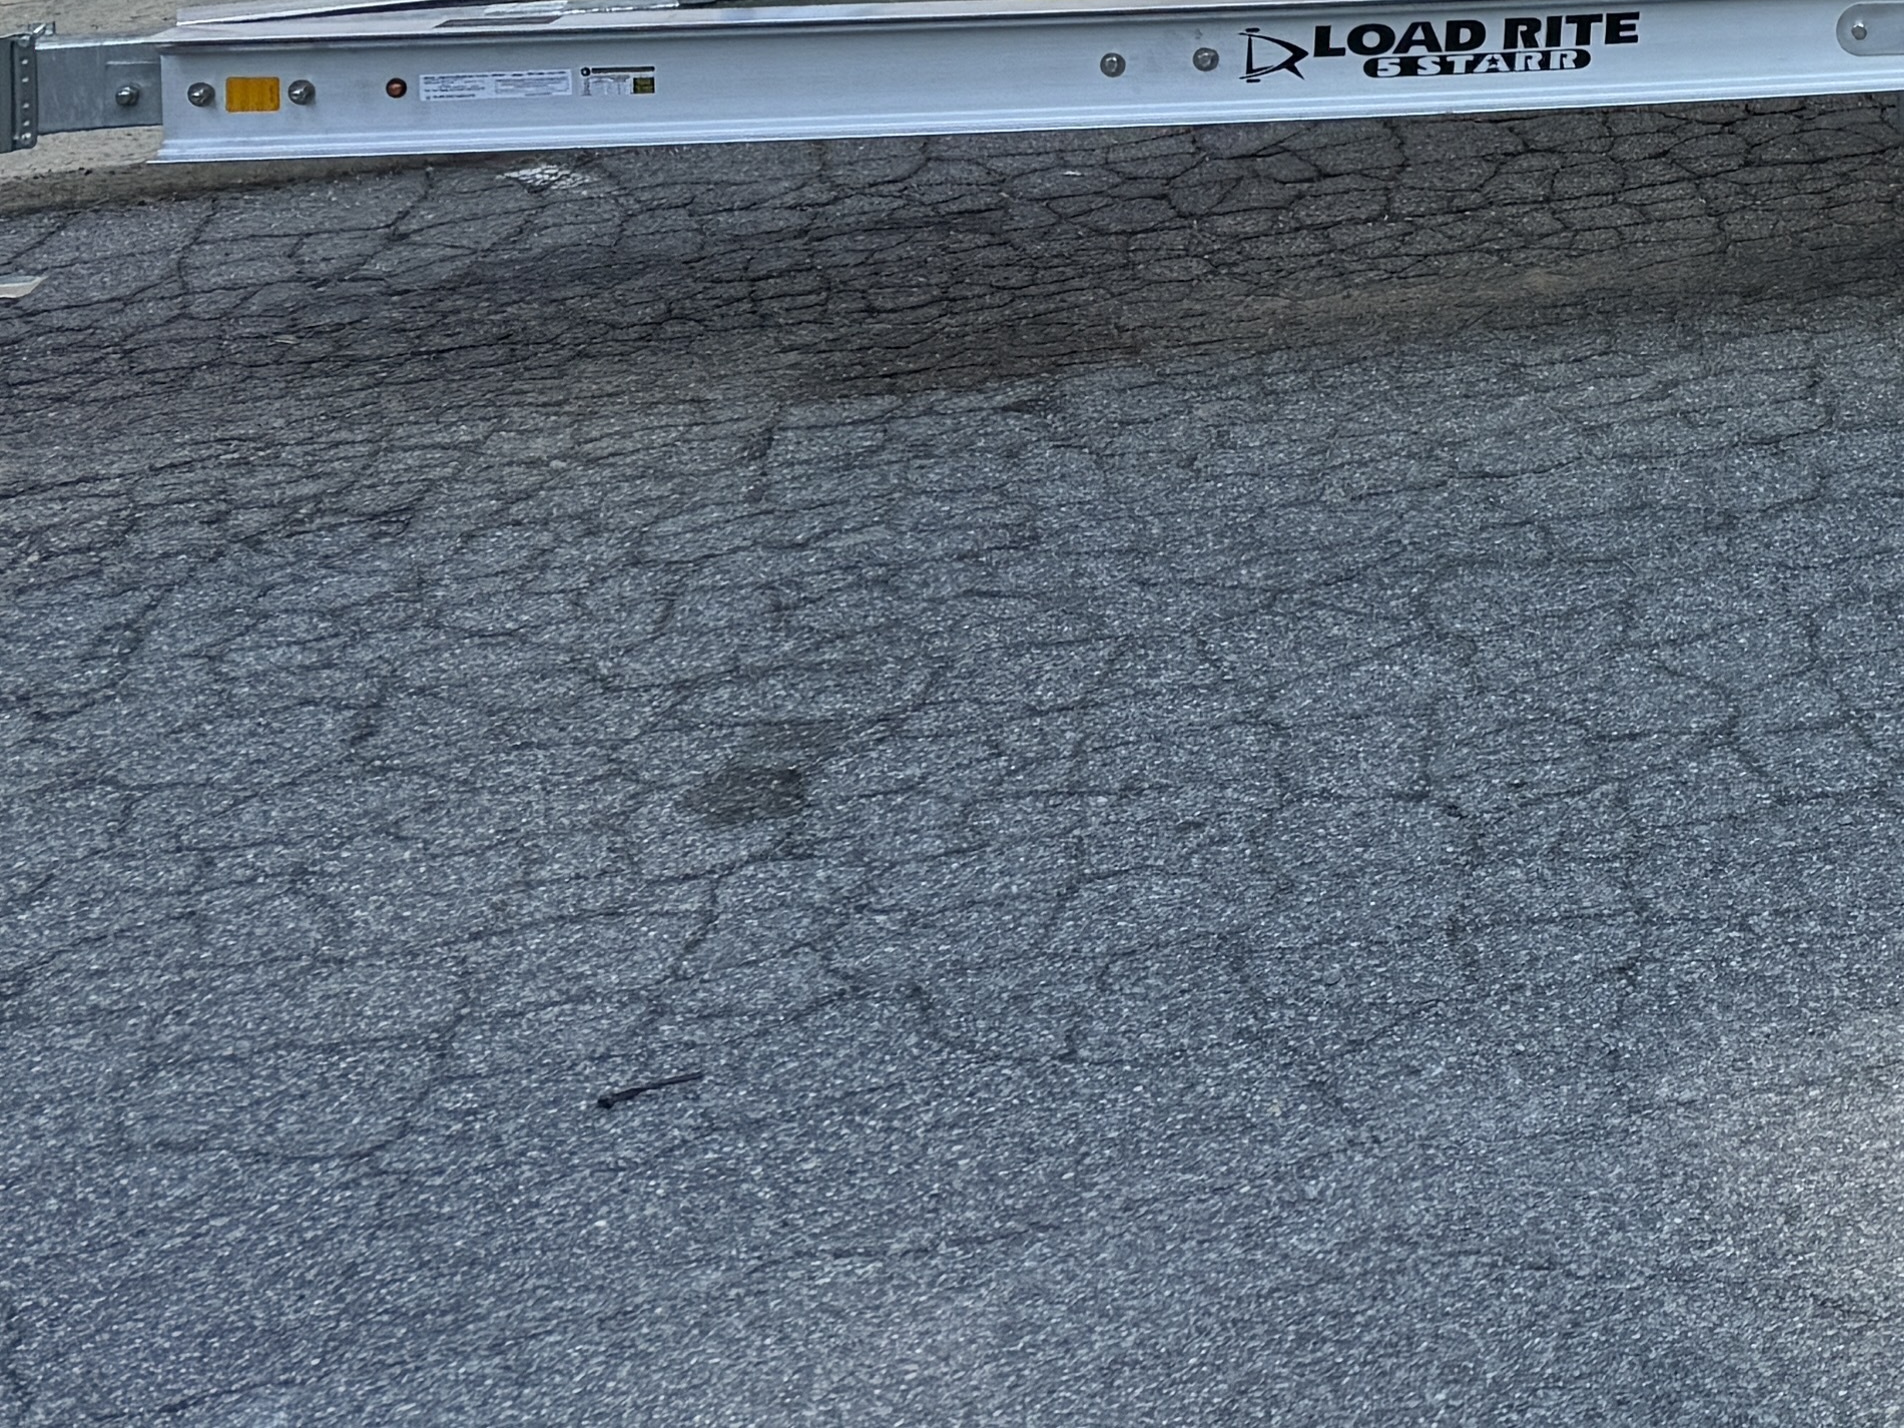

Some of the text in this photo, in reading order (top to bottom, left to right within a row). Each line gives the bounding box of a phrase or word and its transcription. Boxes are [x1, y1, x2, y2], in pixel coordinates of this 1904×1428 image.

[1313, 11, 1640, 58] LOAD RITE
[1376, 49, 1579, 77] 5 STARR
